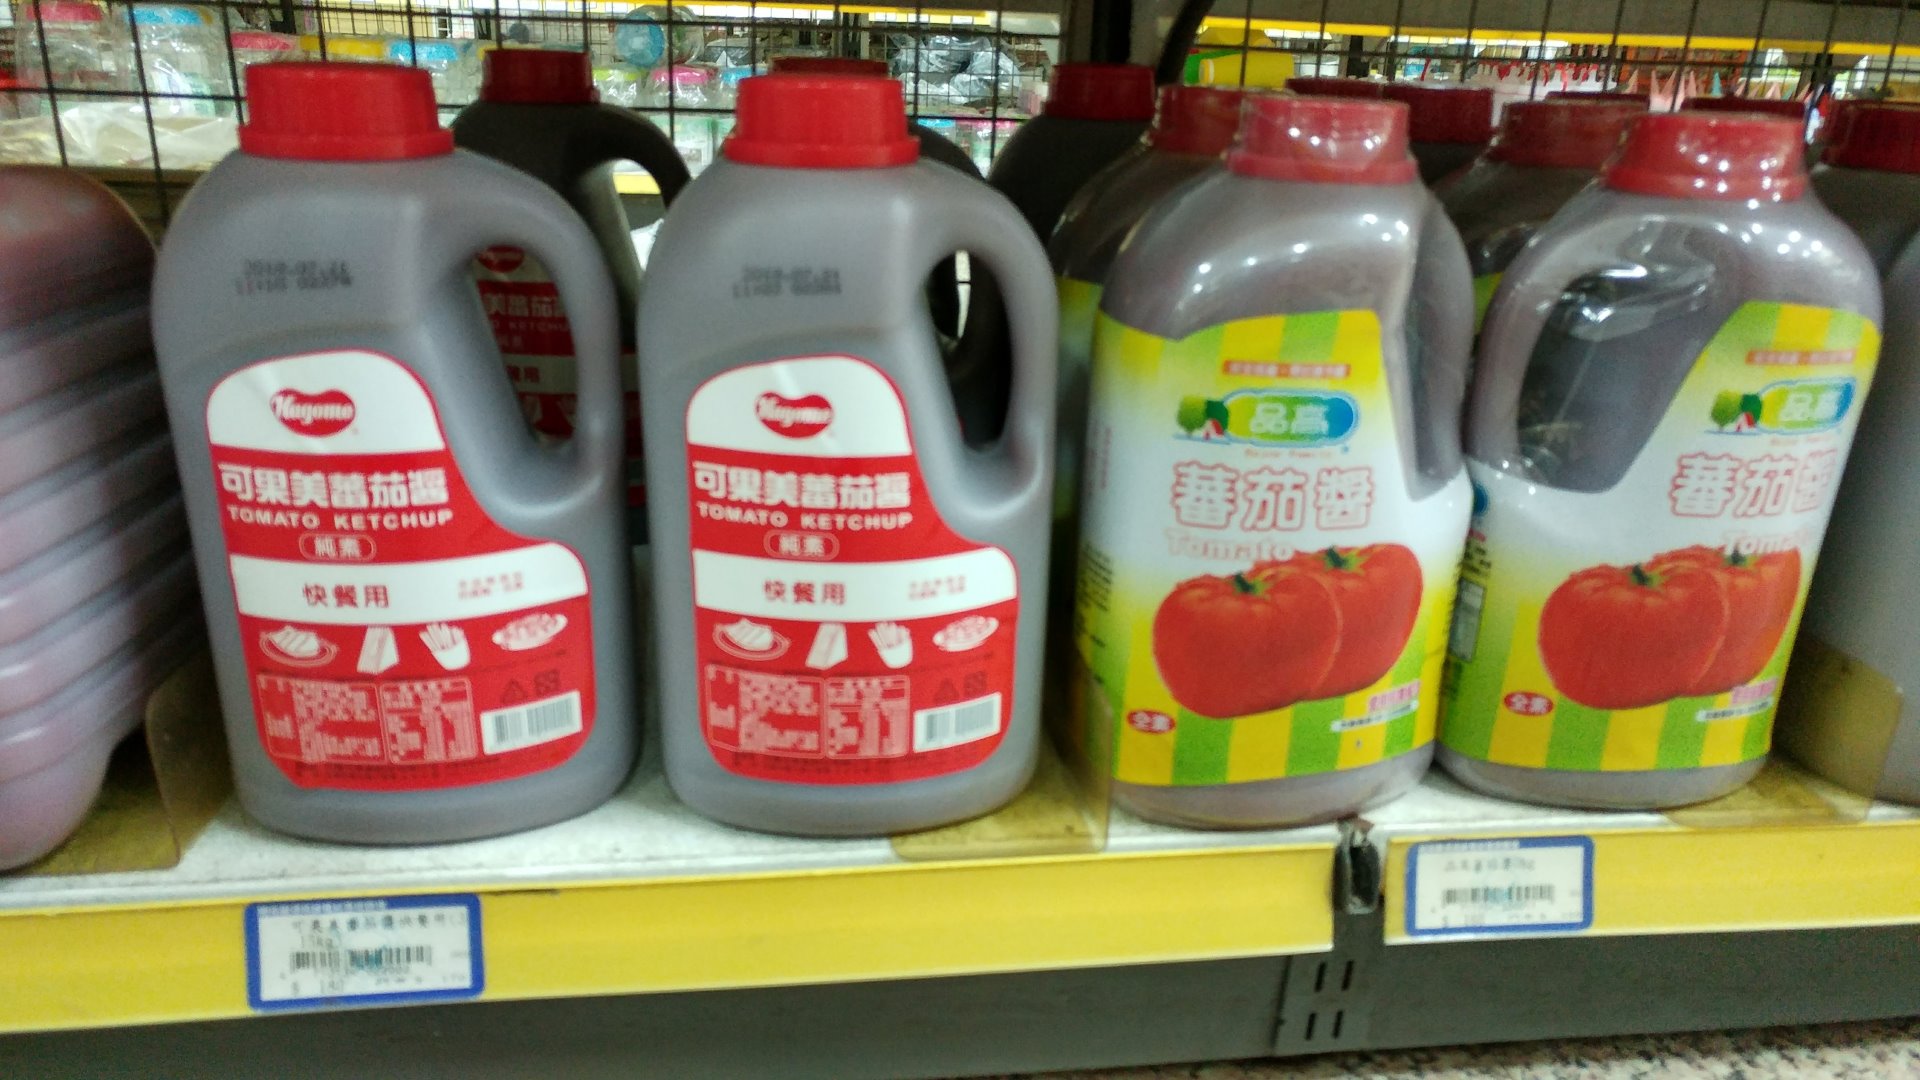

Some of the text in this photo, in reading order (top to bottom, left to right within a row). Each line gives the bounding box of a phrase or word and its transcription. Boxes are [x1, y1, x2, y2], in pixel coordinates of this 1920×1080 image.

[218, 464, 449, 508] 可果美蕃茄醬
[694, 461, 911, 509] 可果美蕃茄醬
[1171, 461, 1374, 531] 蕃茄醬
[227, 506, 453, 531] TOMATO KETCHUP
[697, 502, 913, 531] TOMATO KETCHUP
[302, 583, 389, 609] 快餐用
